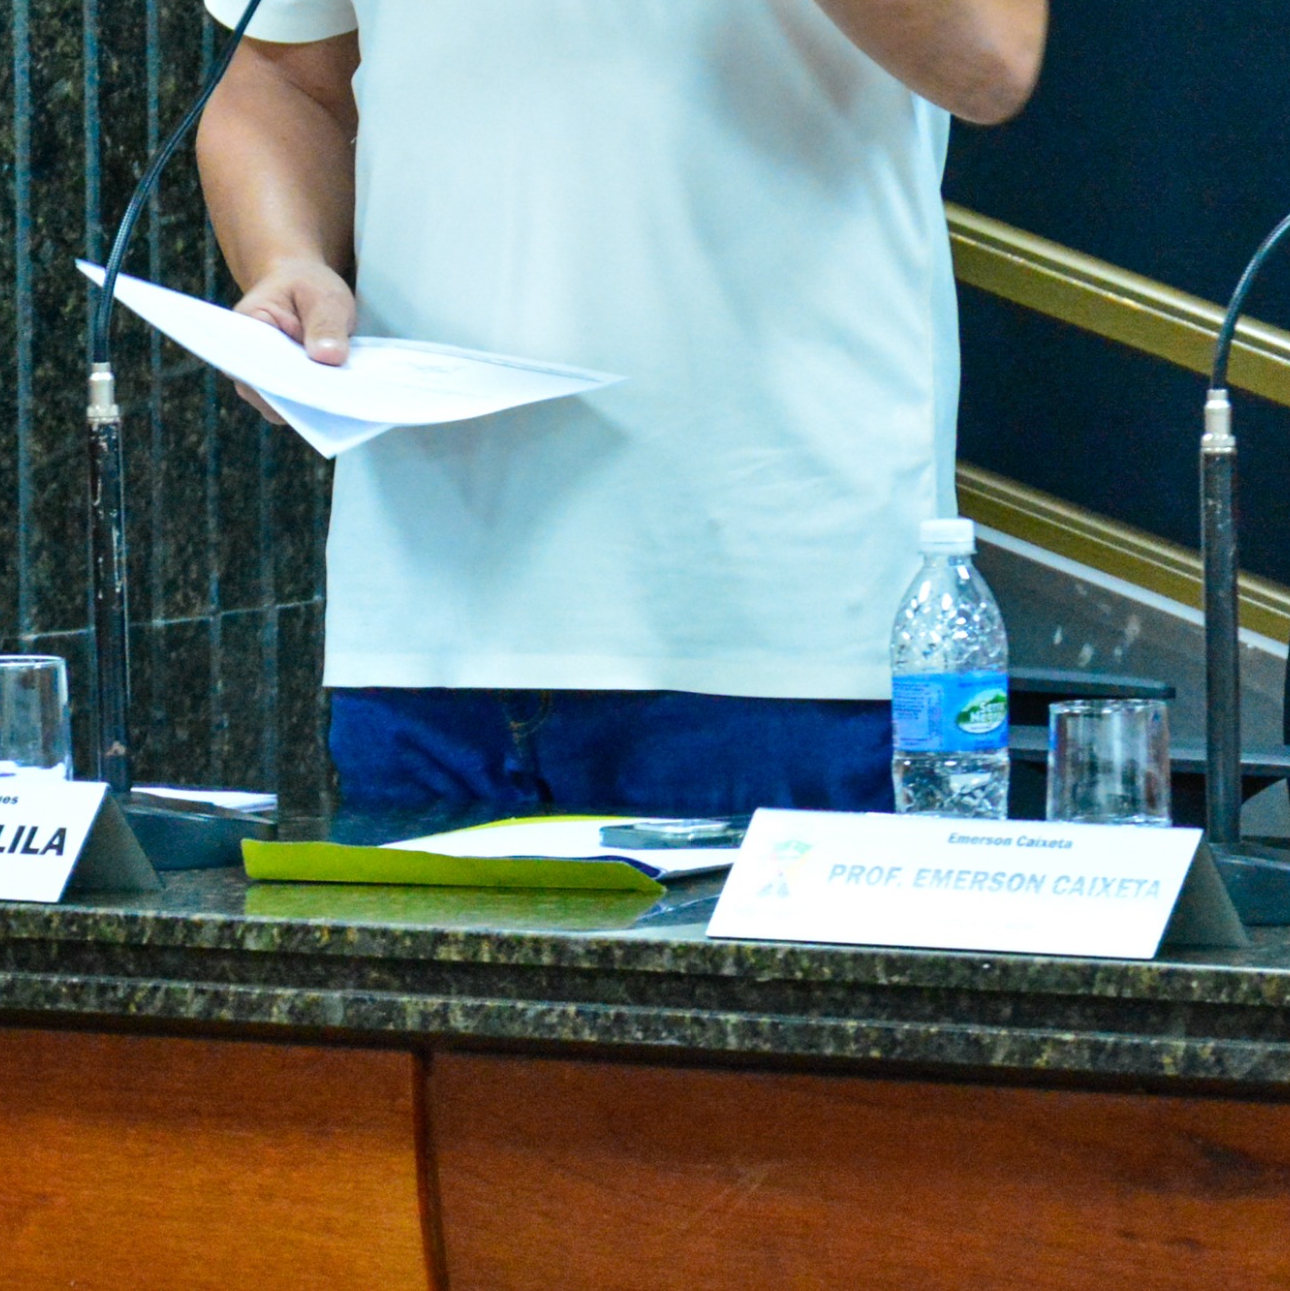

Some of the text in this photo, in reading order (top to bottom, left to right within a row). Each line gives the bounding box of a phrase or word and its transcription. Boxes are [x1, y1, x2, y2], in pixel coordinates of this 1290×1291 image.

[948, 832, 1074, 850] Emerson Caixeta
[827, 863, 1162, 900] PROF. EMERSON CAIXETA
